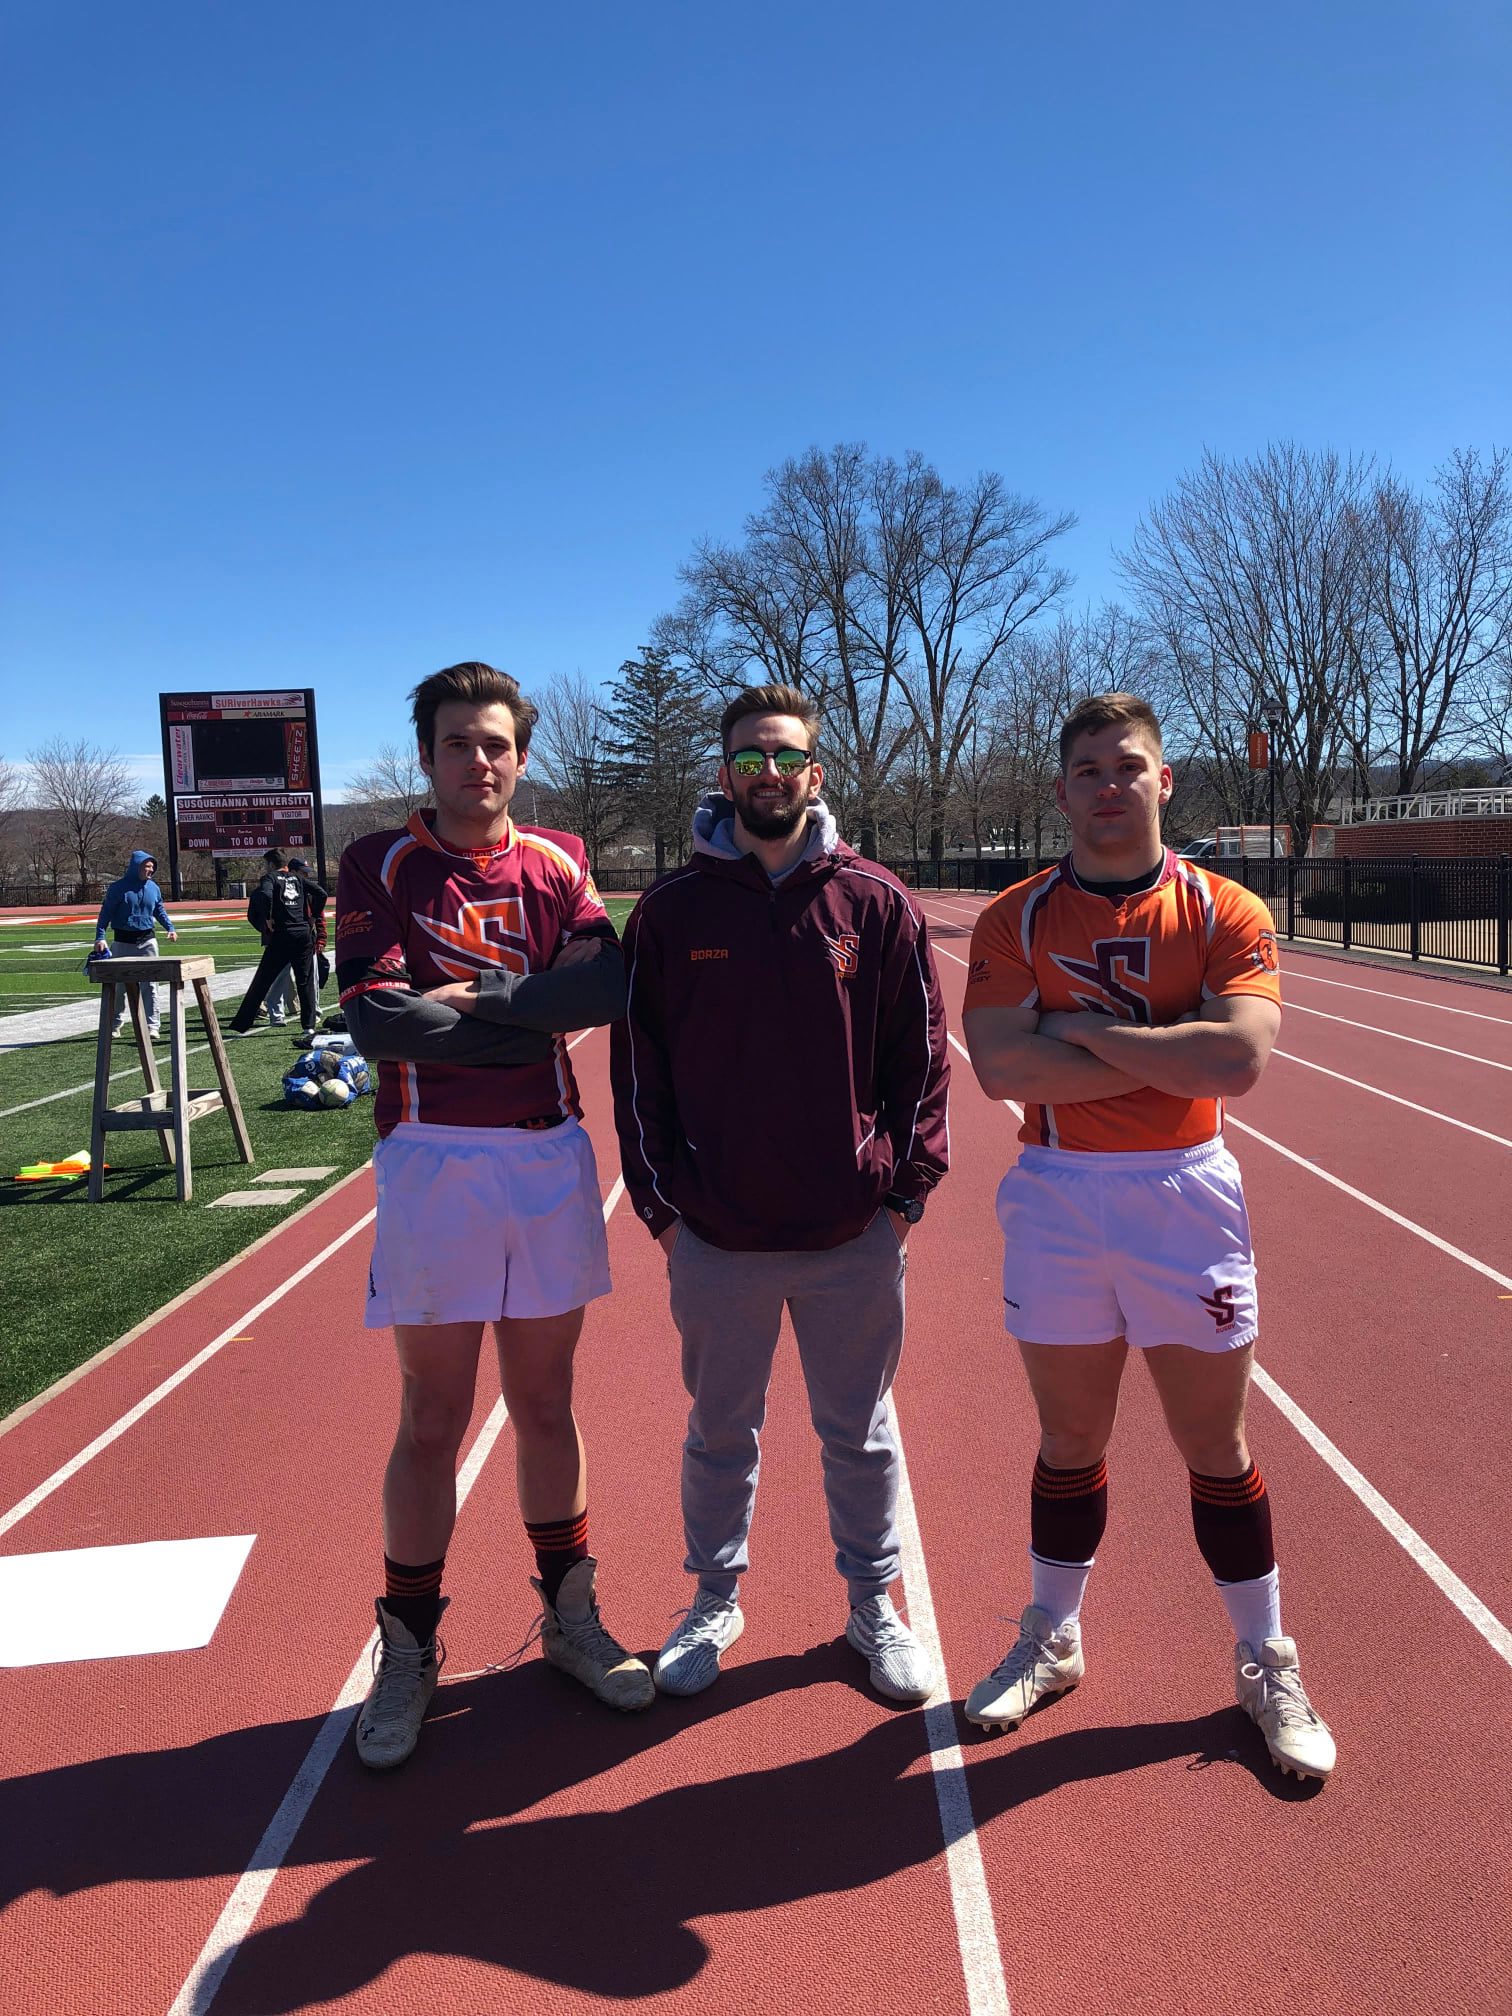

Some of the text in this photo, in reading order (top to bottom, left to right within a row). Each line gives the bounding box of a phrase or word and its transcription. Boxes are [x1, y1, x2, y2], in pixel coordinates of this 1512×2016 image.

[291, 729, 303, 781] SHEETZ
[178, 796, 309, 809] SUSQUEHANNA UNIVERSITY
[180, 812, 214, 822] RIVER HAWKS
[281, 810, 302, 819] VISITOR
[188, 839, 210, 848] DOWN
[230, 837, 268, 847] TO GO ON
[289, 835, 303, 845] QTR
[690, 949, 729, 961] BORZA
